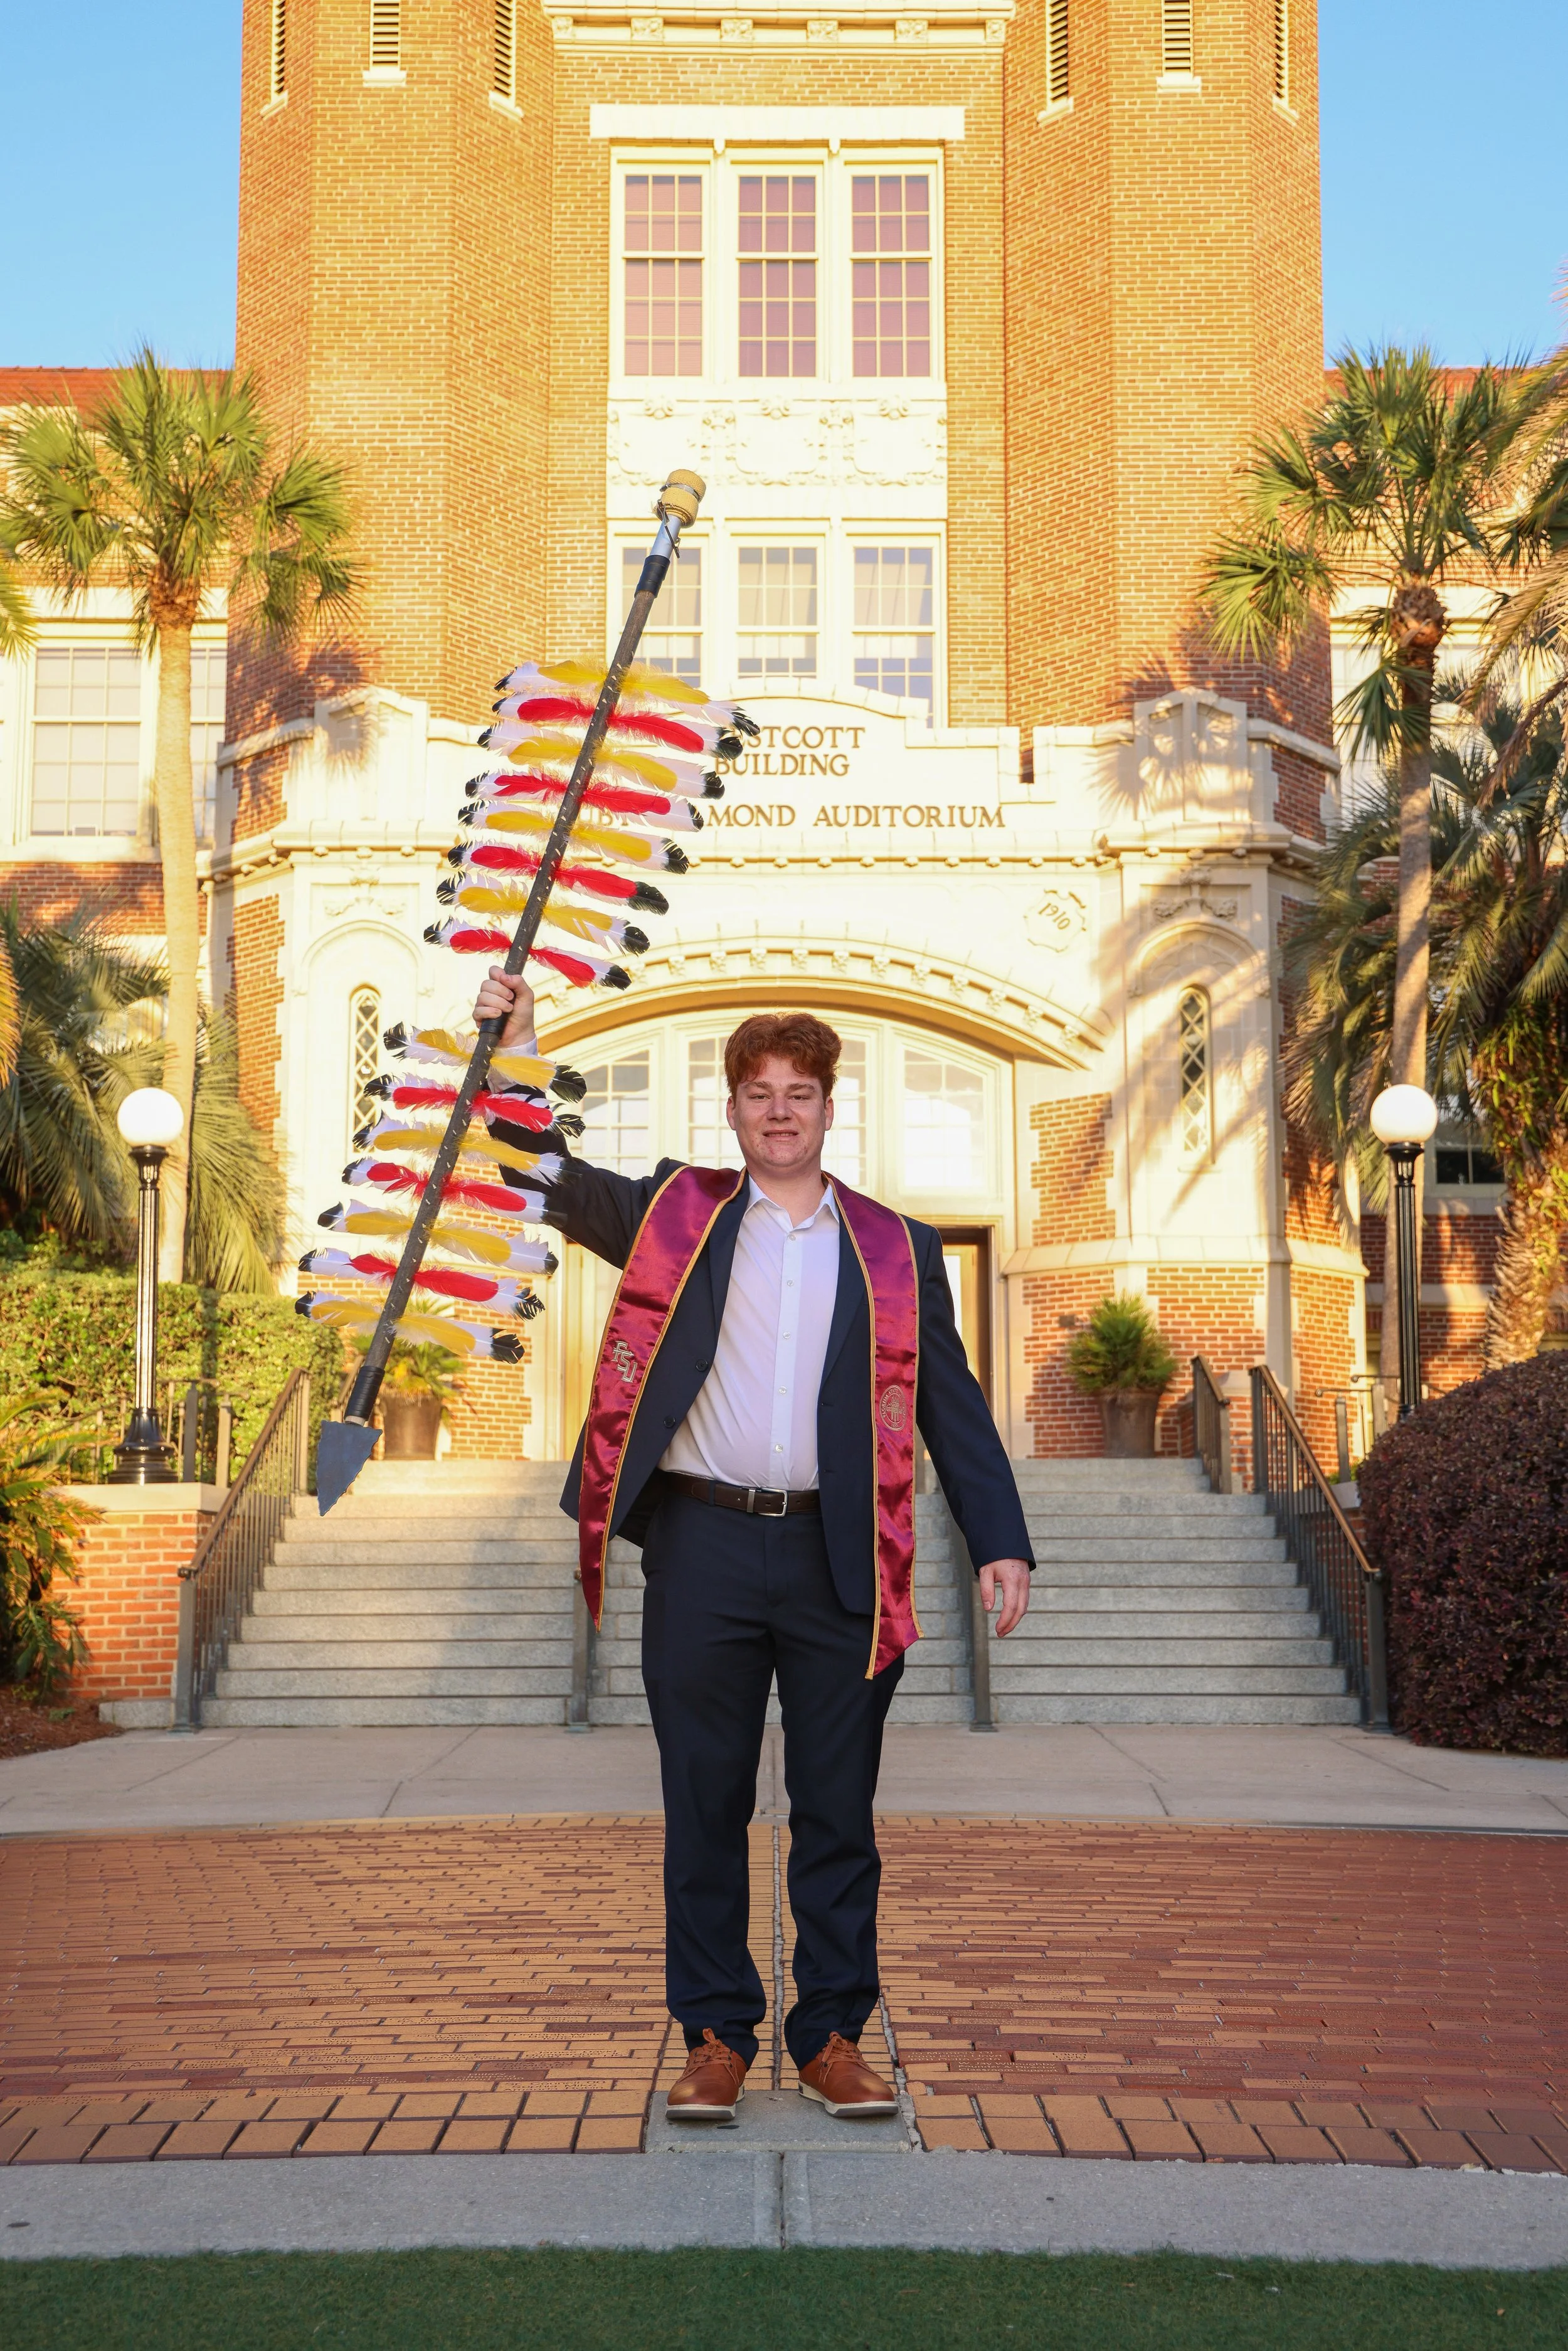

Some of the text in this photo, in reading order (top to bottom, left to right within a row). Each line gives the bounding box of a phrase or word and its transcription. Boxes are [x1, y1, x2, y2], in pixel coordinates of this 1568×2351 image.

[714, 753, 850, 777] BUILDING
[812, 805, 1006, 828] AUDITORIUM
[1038, 903, 1070, 930] 1910
[612, 1340, 638, 1383] FSU
